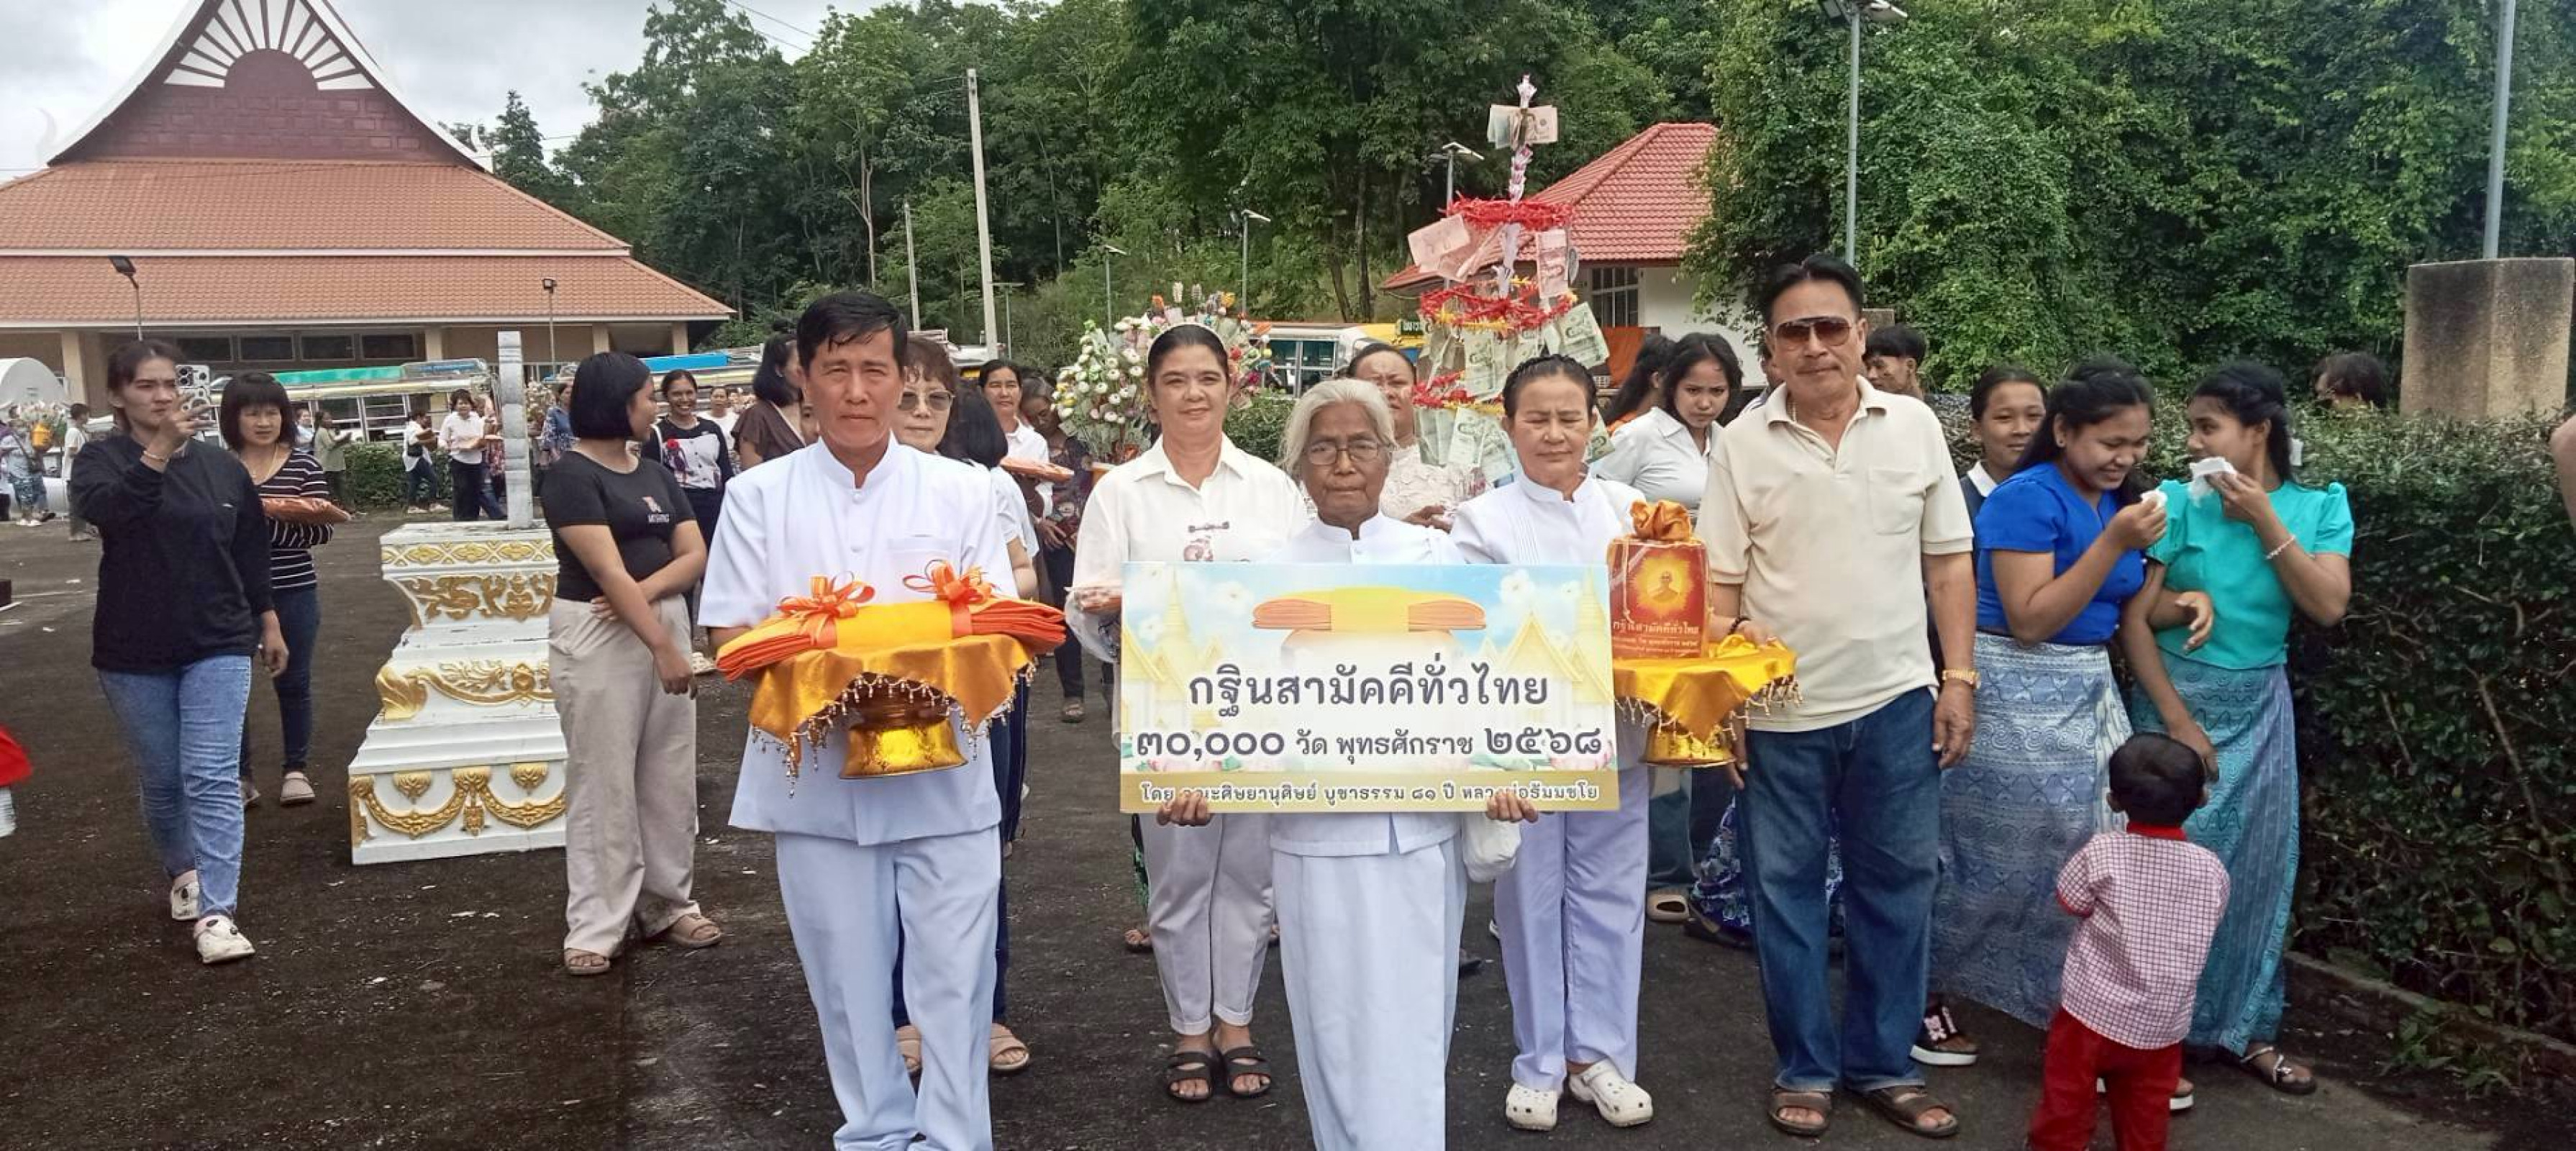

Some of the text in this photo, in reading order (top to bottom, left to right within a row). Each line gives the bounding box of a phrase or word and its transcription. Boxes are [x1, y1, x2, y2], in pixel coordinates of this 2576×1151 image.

[1188, 652, 1547, 717] กฐินสามัคคีทั่วไทย
[1137, 727, 1602, 765] ๓๐,๐๐๐ วัด พุทธศักราช ๒๕๖๘
[1142, 783, 1173, 801] โดย
[1324, 787, 1405, 806] บูชาธรรม
[1411, 787, 1436, 801] ๘๑
[1442, 782, 1455, 800] ปี
